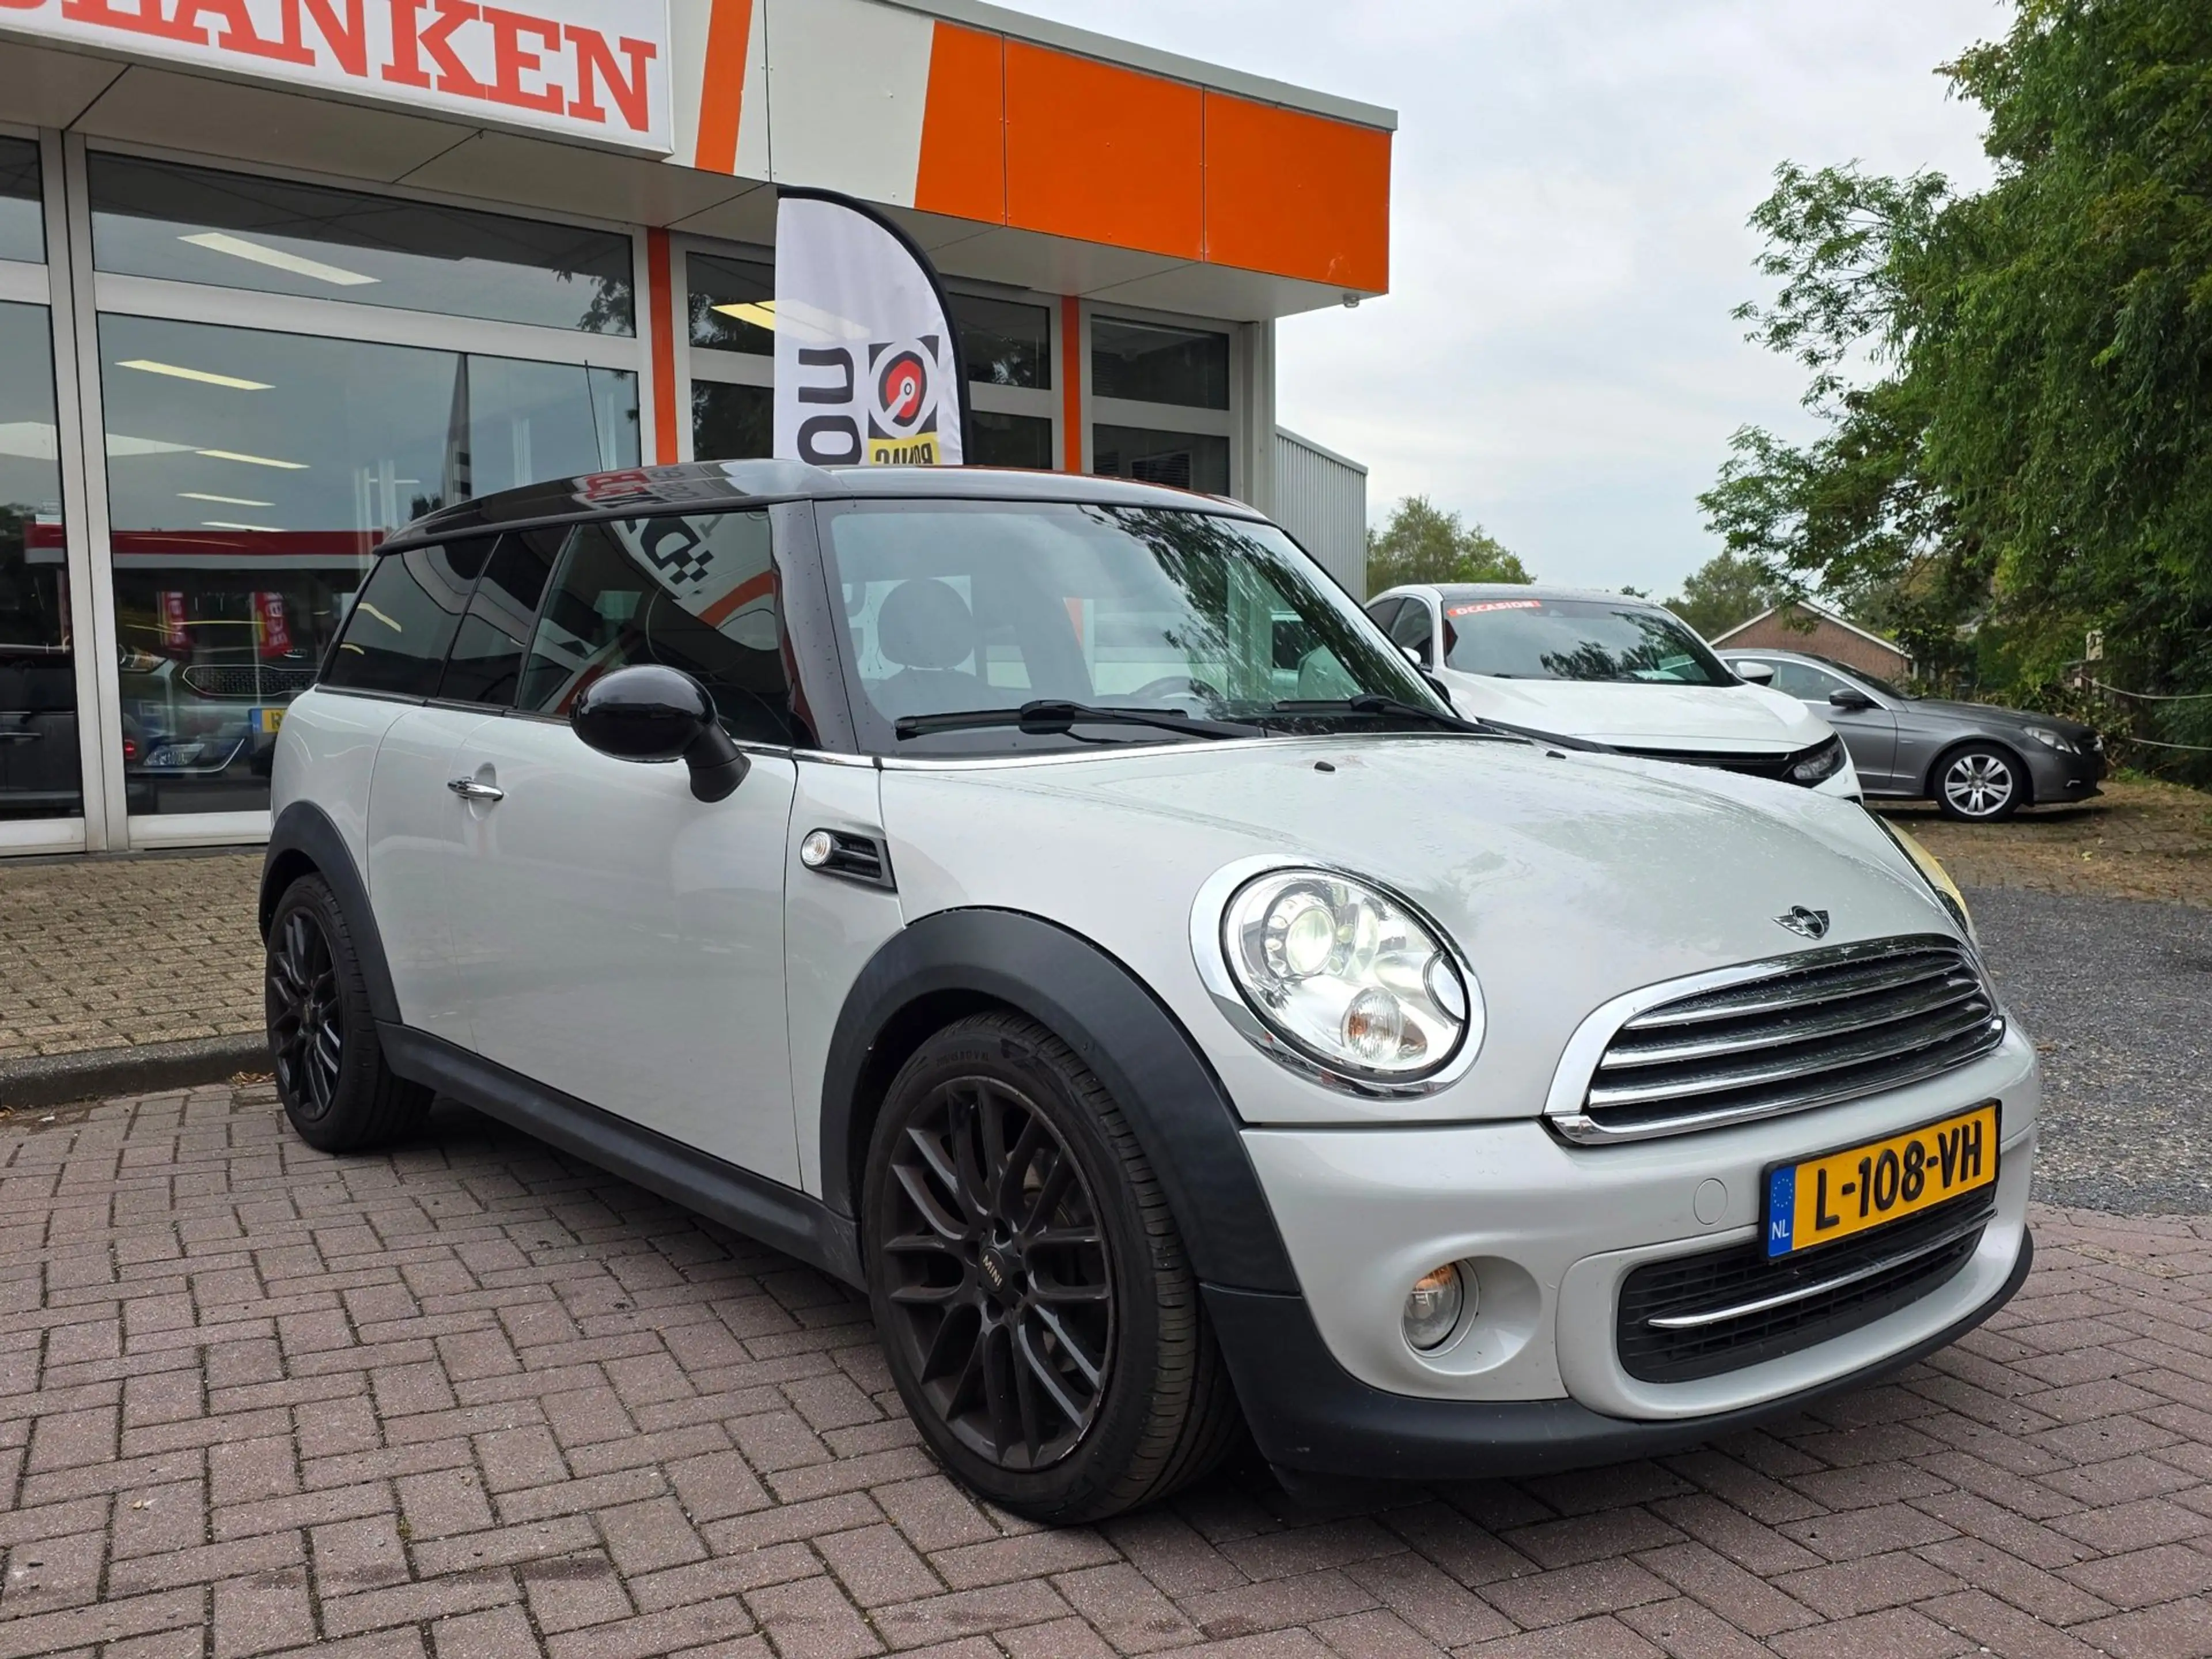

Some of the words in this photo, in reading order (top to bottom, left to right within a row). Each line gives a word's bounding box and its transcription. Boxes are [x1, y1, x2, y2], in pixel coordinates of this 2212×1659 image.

[0, 0, 657, 132] ANKEN
[1815, 1119, 1982, 1231] L-108-VH
[1771, 1218, 1790, 1241] NL
[983, 1255, 1002, 1286] MINI
